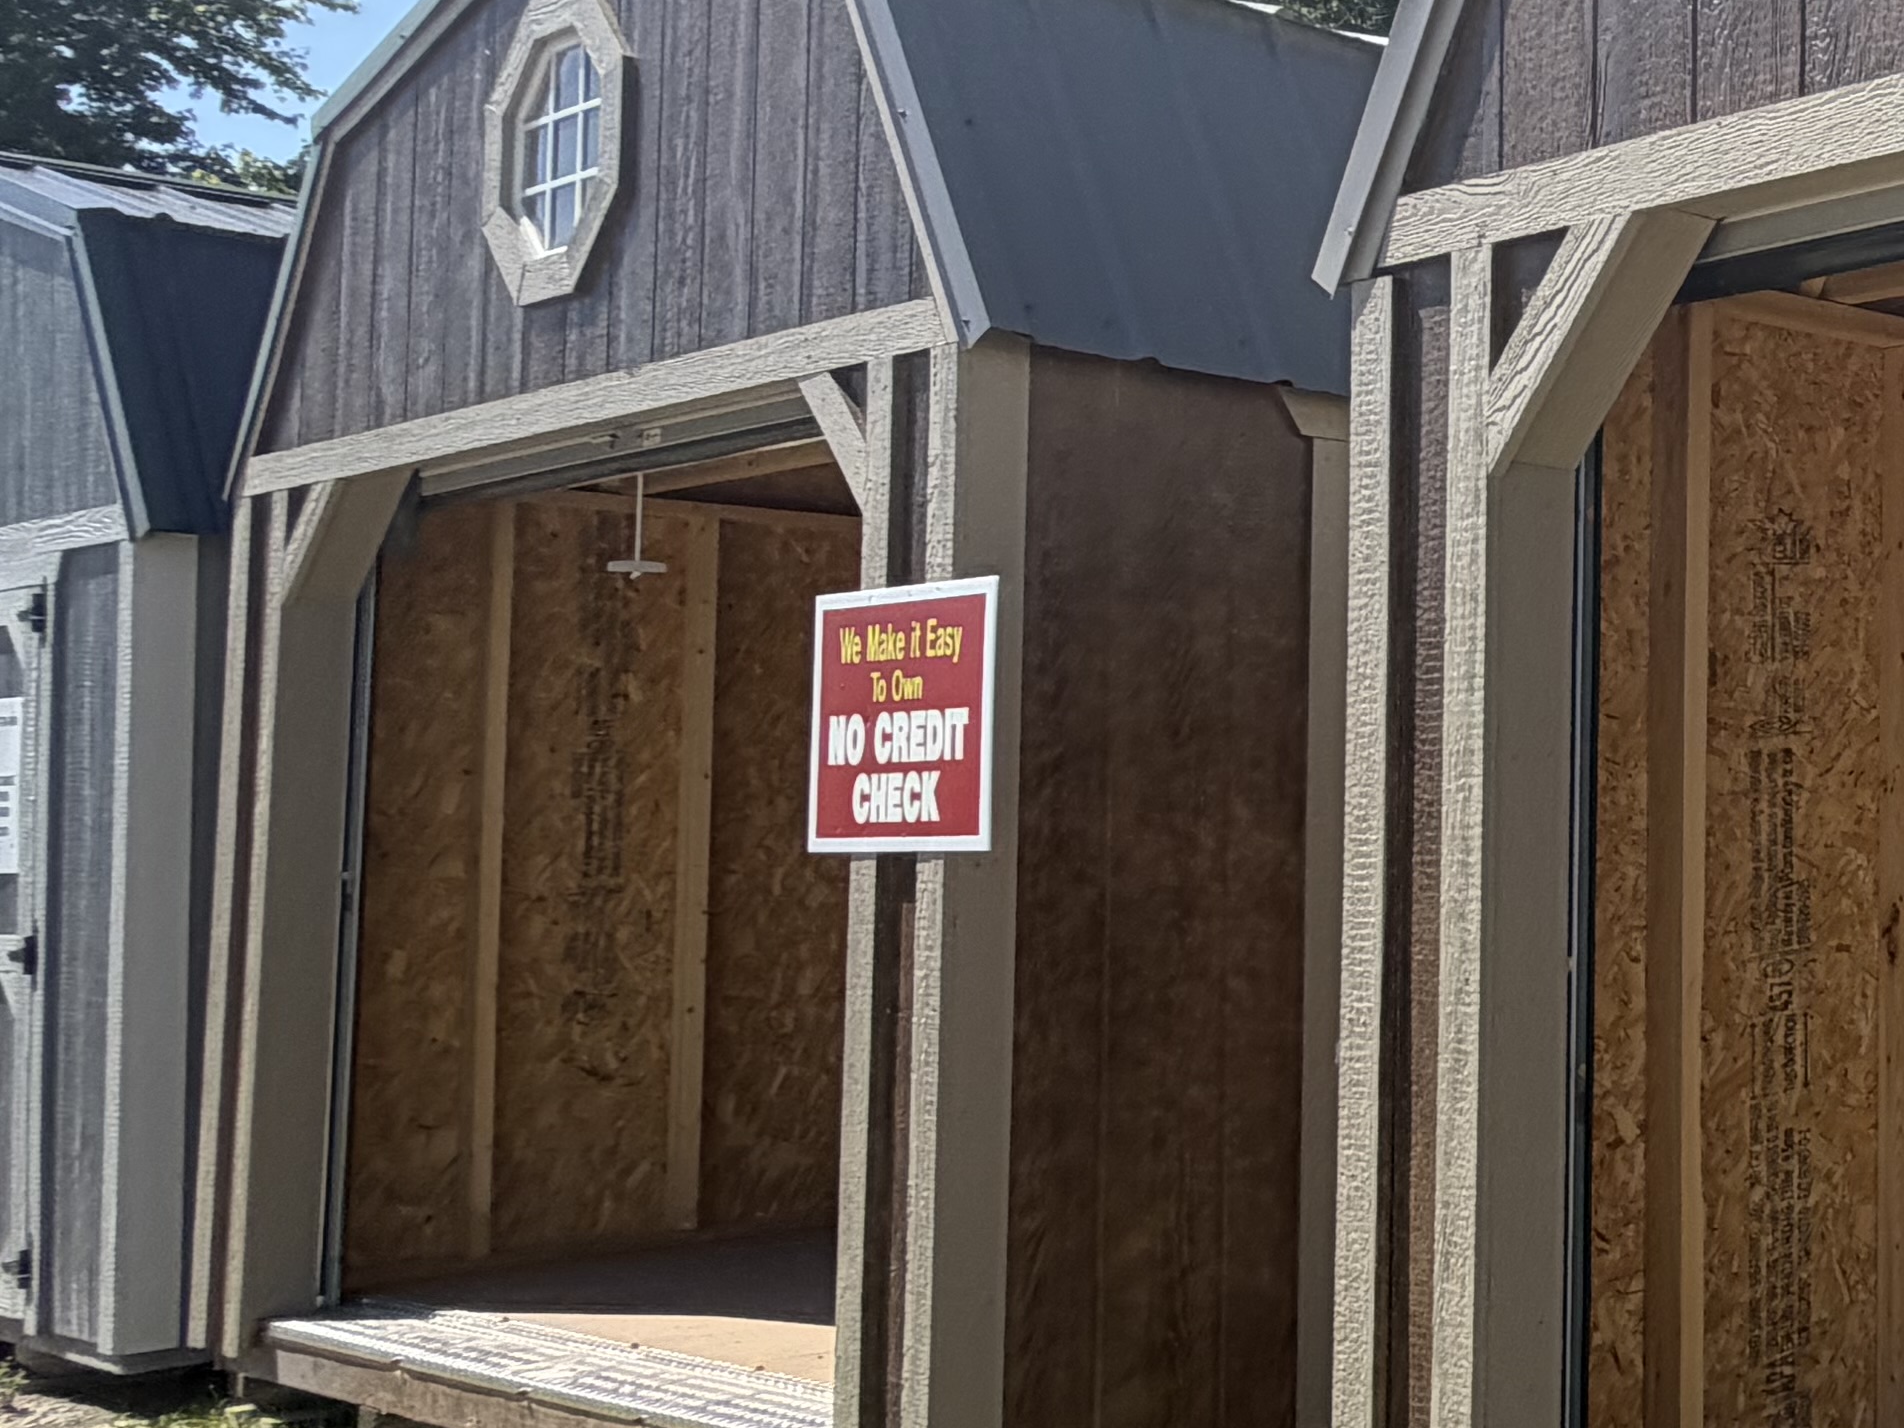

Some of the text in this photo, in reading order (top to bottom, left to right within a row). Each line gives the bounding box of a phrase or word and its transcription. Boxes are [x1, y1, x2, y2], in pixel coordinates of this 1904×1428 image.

[839, 617, 963, 665] We Make it Easy
[870, 669, 923, 703] To Own
[827, 706, 970, 766] NO CREDIT
[852, 770, 941, 825] CHECK
